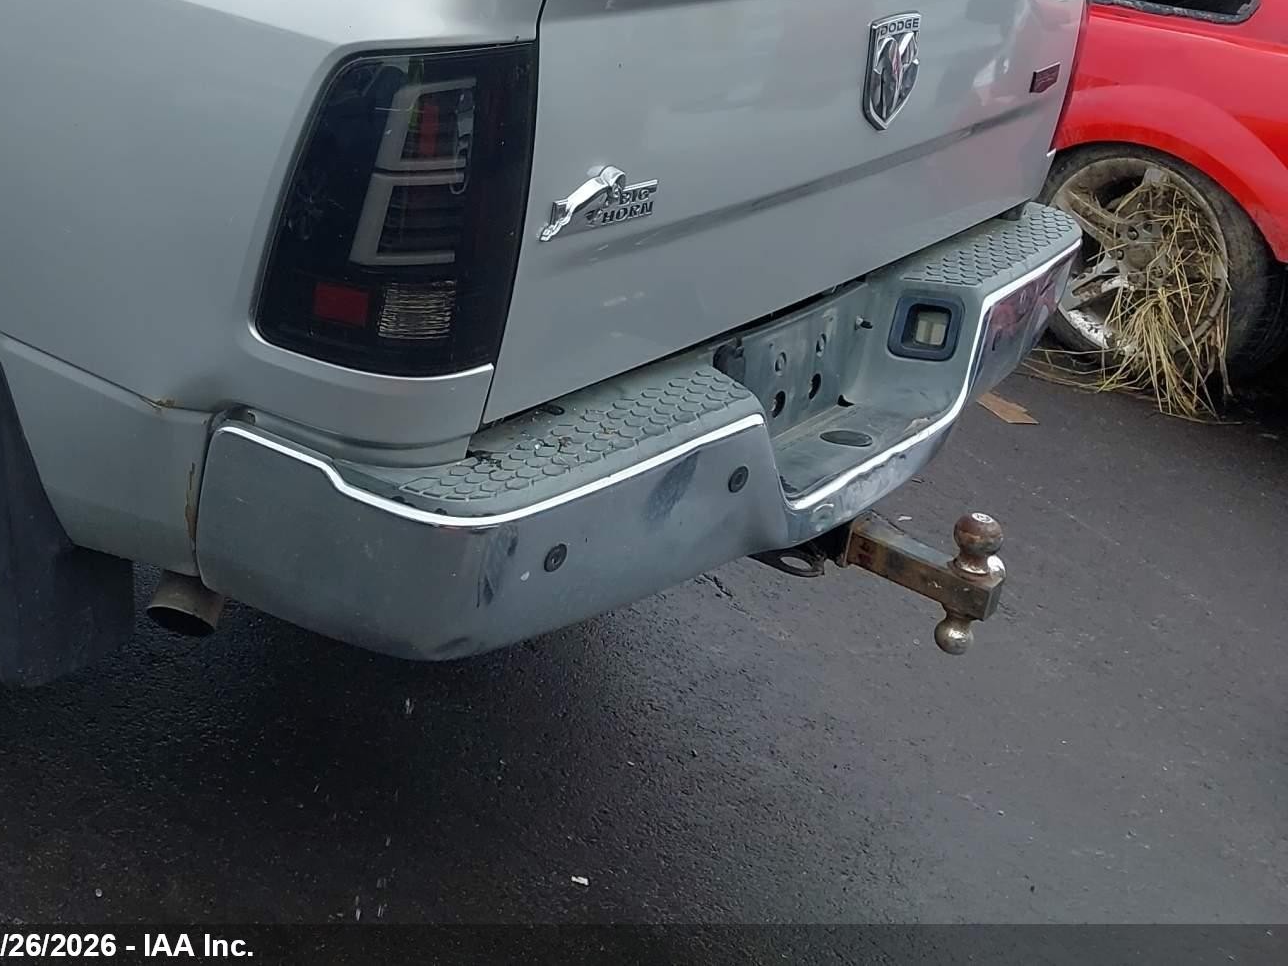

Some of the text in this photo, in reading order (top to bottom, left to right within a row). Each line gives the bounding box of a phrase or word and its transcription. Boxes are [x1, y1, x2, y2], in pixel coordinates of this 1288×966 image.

[880, 18, 920, 35] DODGE
[618, 187, 650, 205] BIG
[600, 200, 654, 225] HORN
